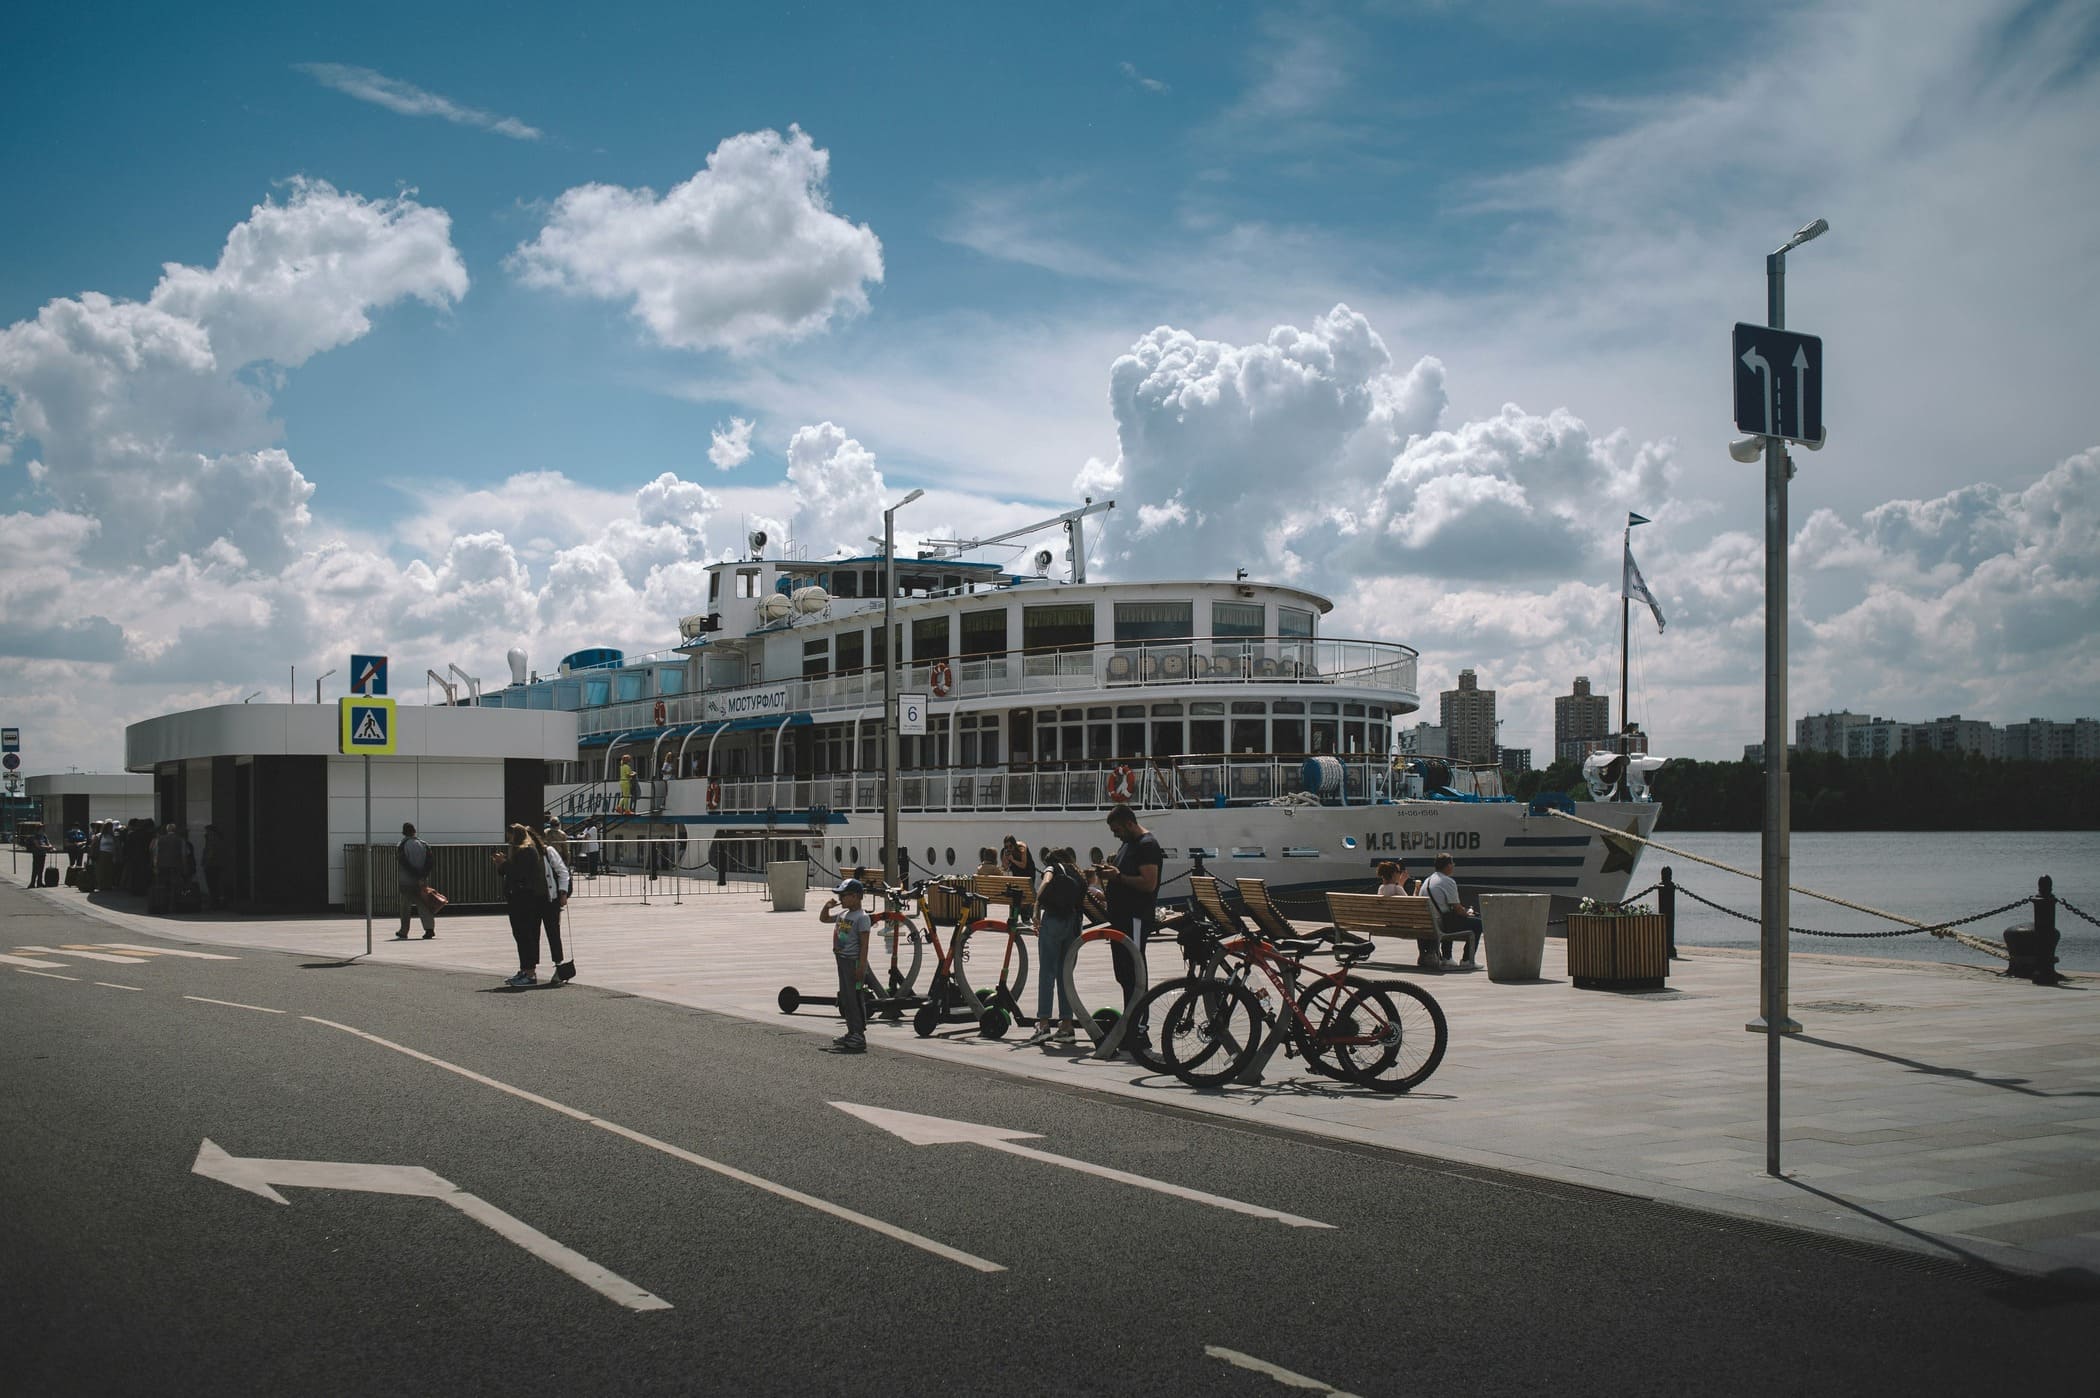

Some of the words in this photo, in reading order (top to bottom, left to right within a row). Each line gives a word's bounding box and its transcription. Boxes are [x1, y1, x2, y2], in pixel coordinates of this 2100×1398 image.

[728, 692, 785, 712] МОСТУРФЛОТ
[908, 706, 917, 721] 6
[1401, 831, 1481, 850] КРЫЛОВ
